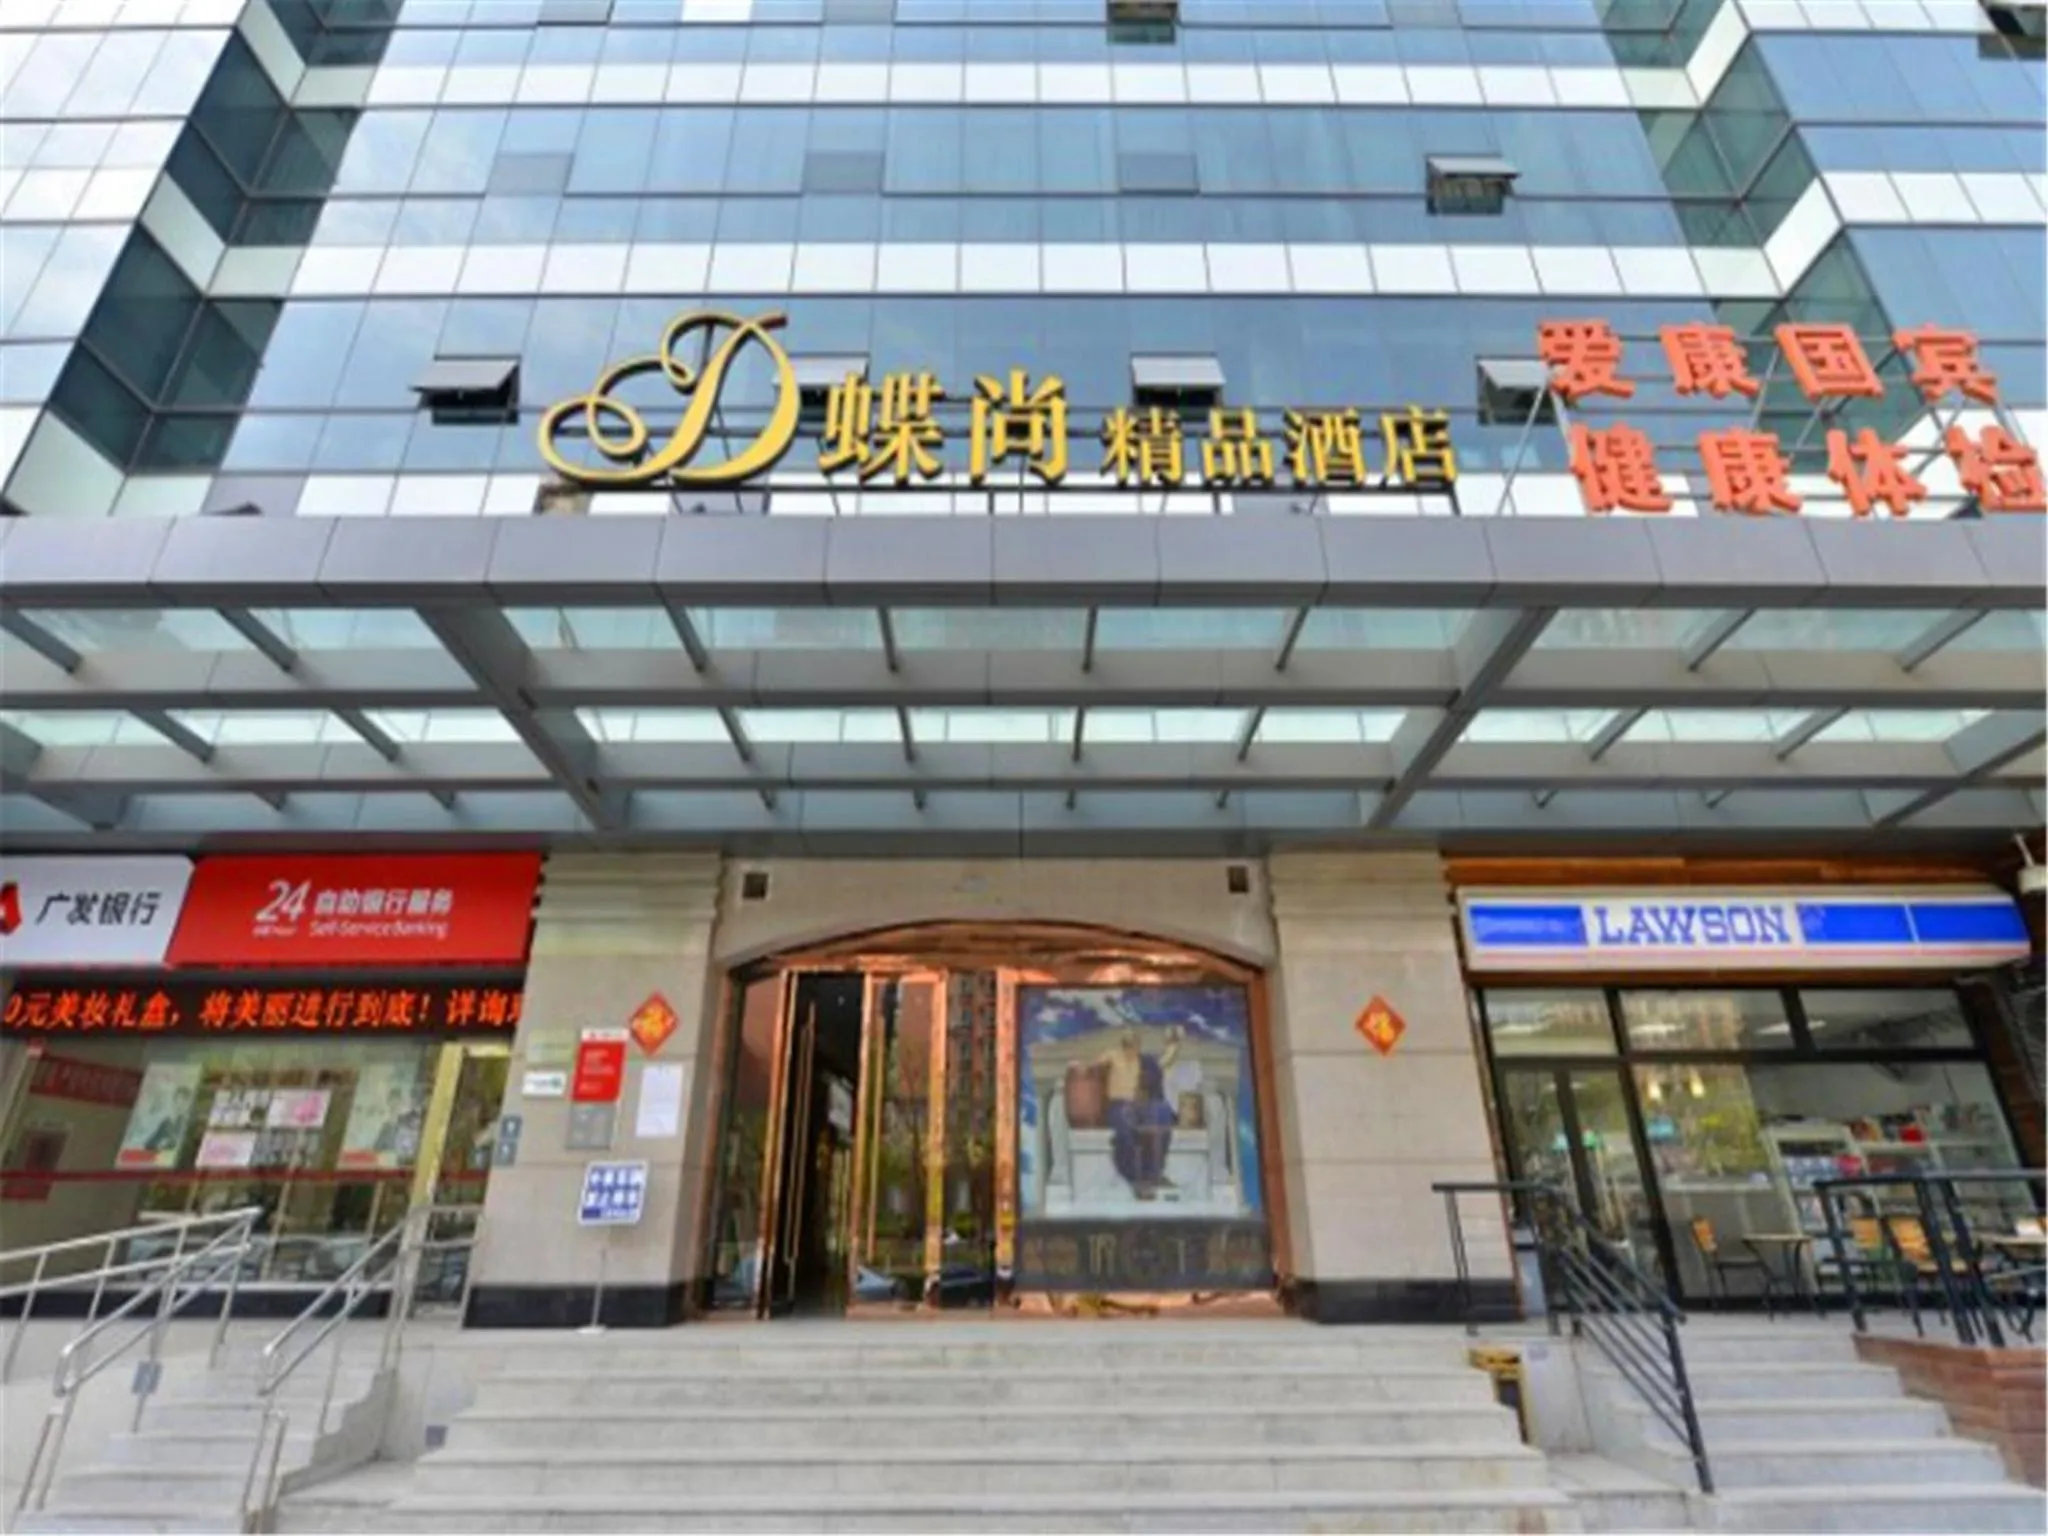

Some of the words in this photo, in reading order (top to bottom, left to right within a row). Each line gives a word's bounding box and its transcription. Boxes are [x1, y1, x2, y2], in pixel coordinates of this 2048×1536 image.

[1537, 317, 1997, 406] 爱康国宾
[819, 366, 1068, 484] 蝶尚
[1101, 404, 1460, 490] 精品酒店
[1568, 421, 2047, 515] 健康体检
[34, 889, 162, 926] 广发银行
[255, 878, 312, 923] 24
[314, 887, 454, 917] 自助银行服务
[1594, 904, 1792, 944] LAWSON
